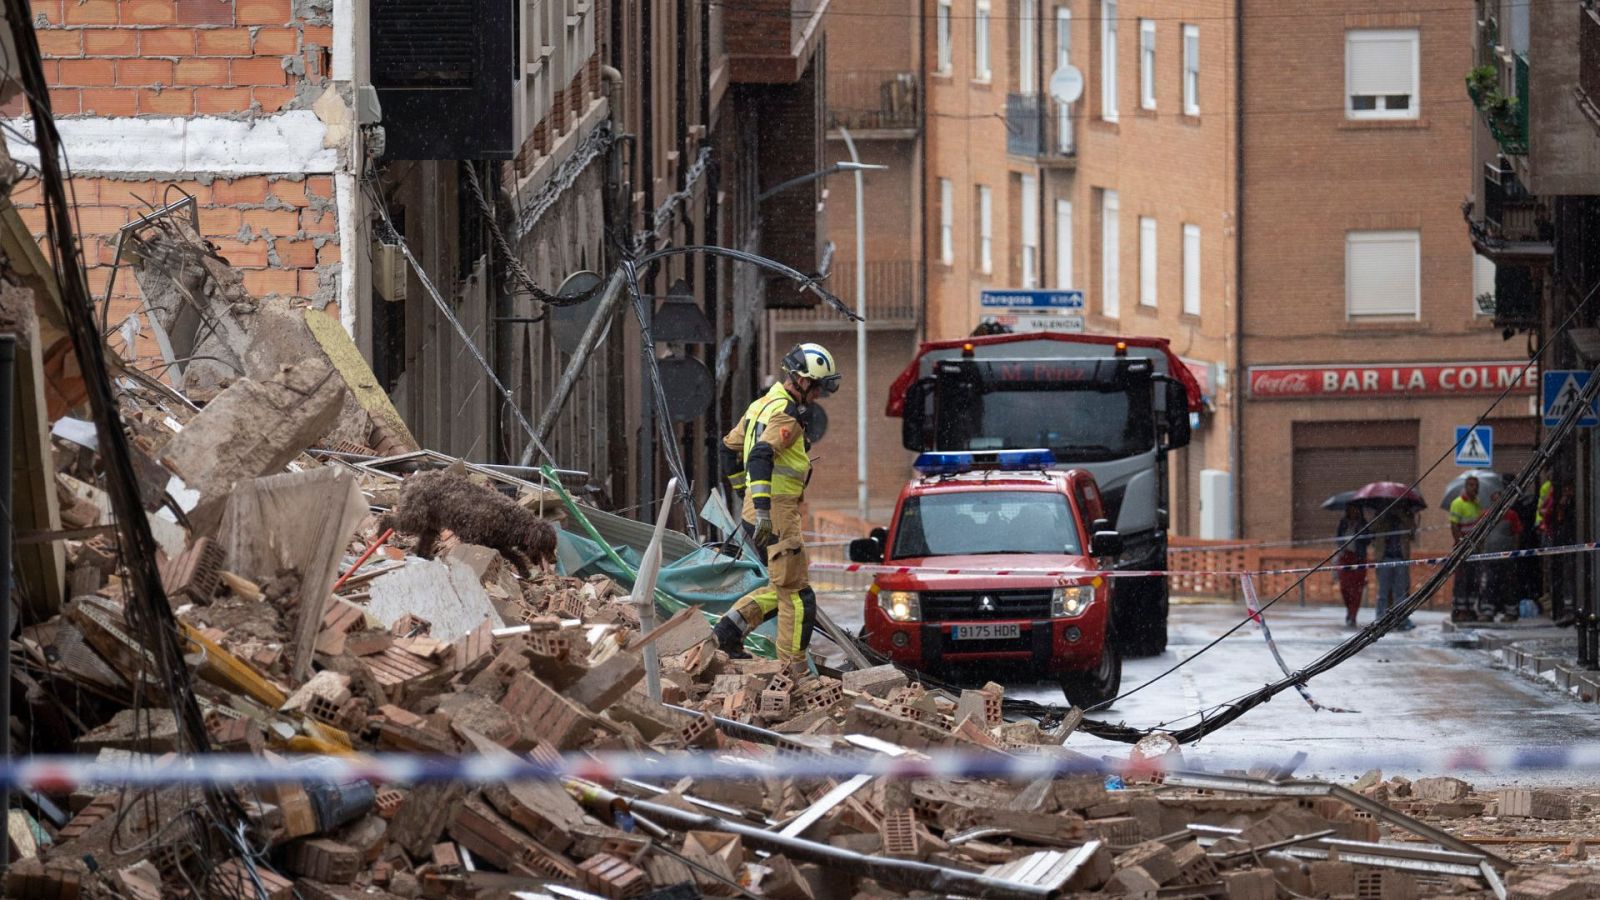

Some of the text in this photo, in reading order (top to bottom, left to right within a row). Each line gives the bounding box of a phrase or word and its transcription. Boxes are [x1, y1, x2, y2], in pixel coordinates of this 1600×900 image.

[983, 294, 1033, 305] Zaragoza
[1031, 320, 1080, 329] VALENCIA
[1322, 370, 1379, 392] BAR
[1391, 368, 1426, 391] LA
[960, 625, 1017, 638] 9175 HDR
